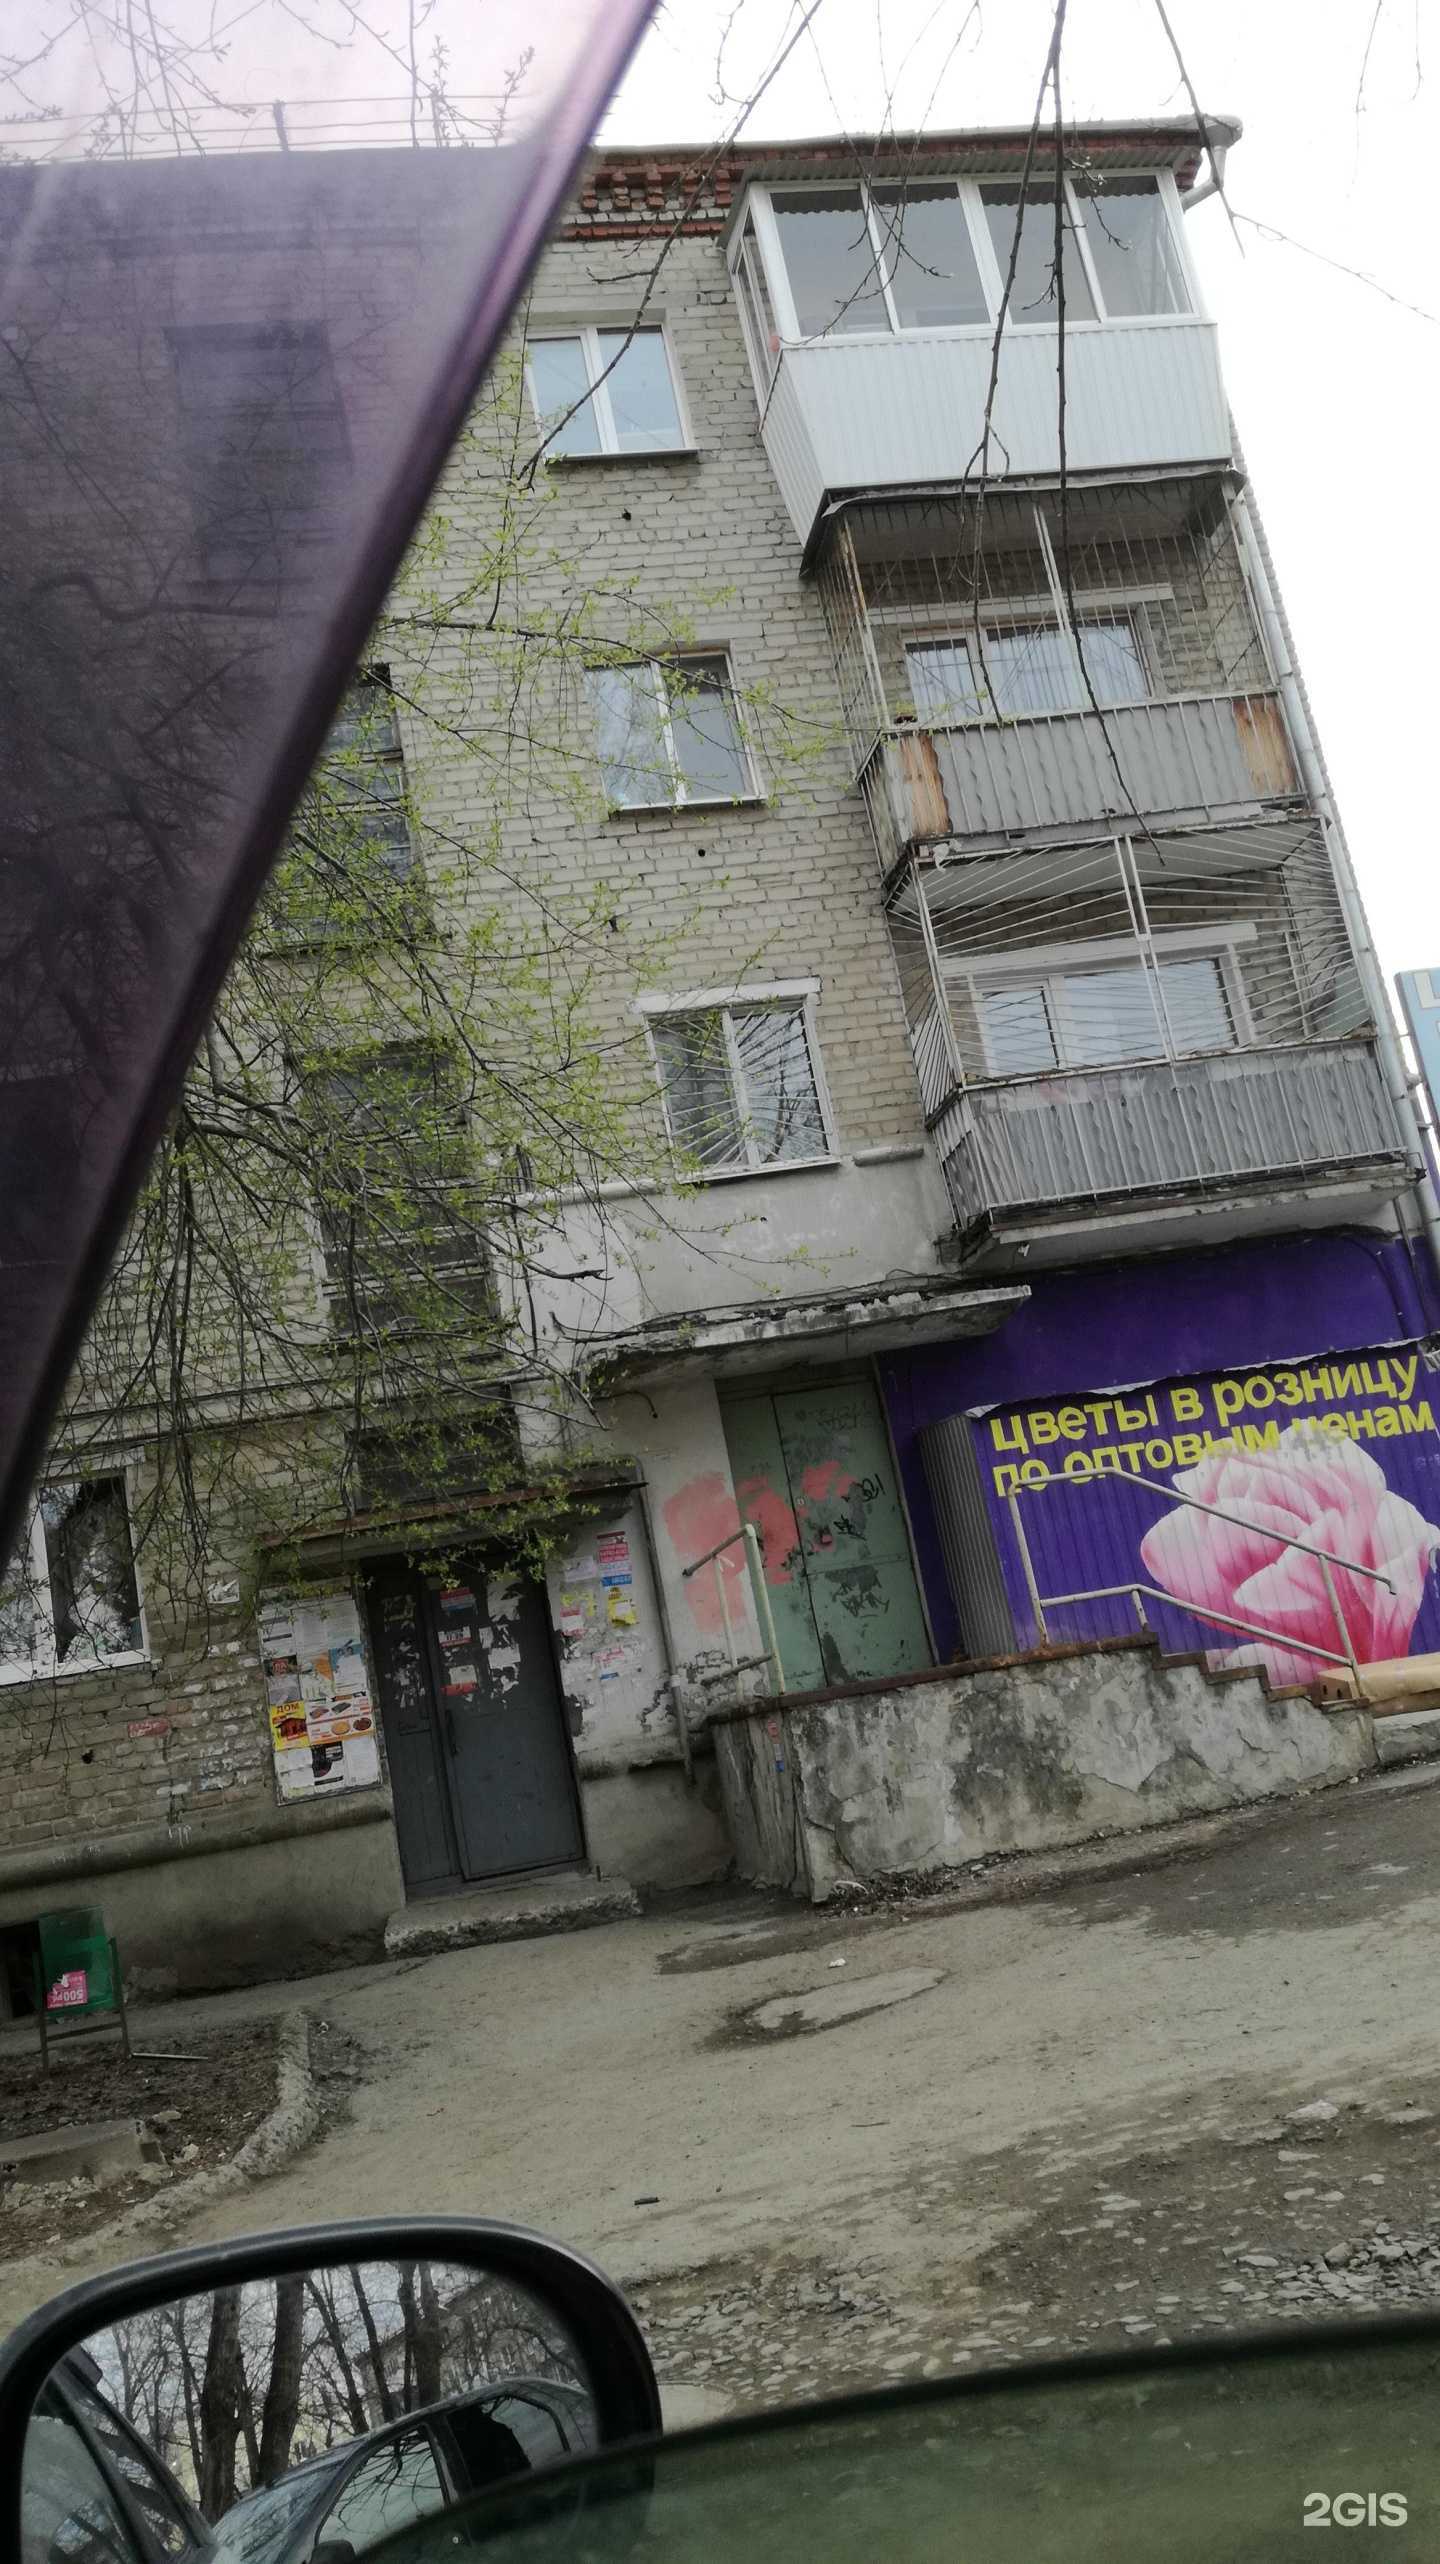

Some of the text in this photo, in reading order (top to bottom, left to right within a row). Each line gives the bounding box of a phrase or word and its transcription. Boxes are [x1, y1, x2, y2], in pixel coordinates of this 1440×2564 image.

[990, 1355, 1418, 1455] цветы в розницу
[992, 1459, 1051, 1498] по
[1063, 1420, 1282, 1485] оптовым
